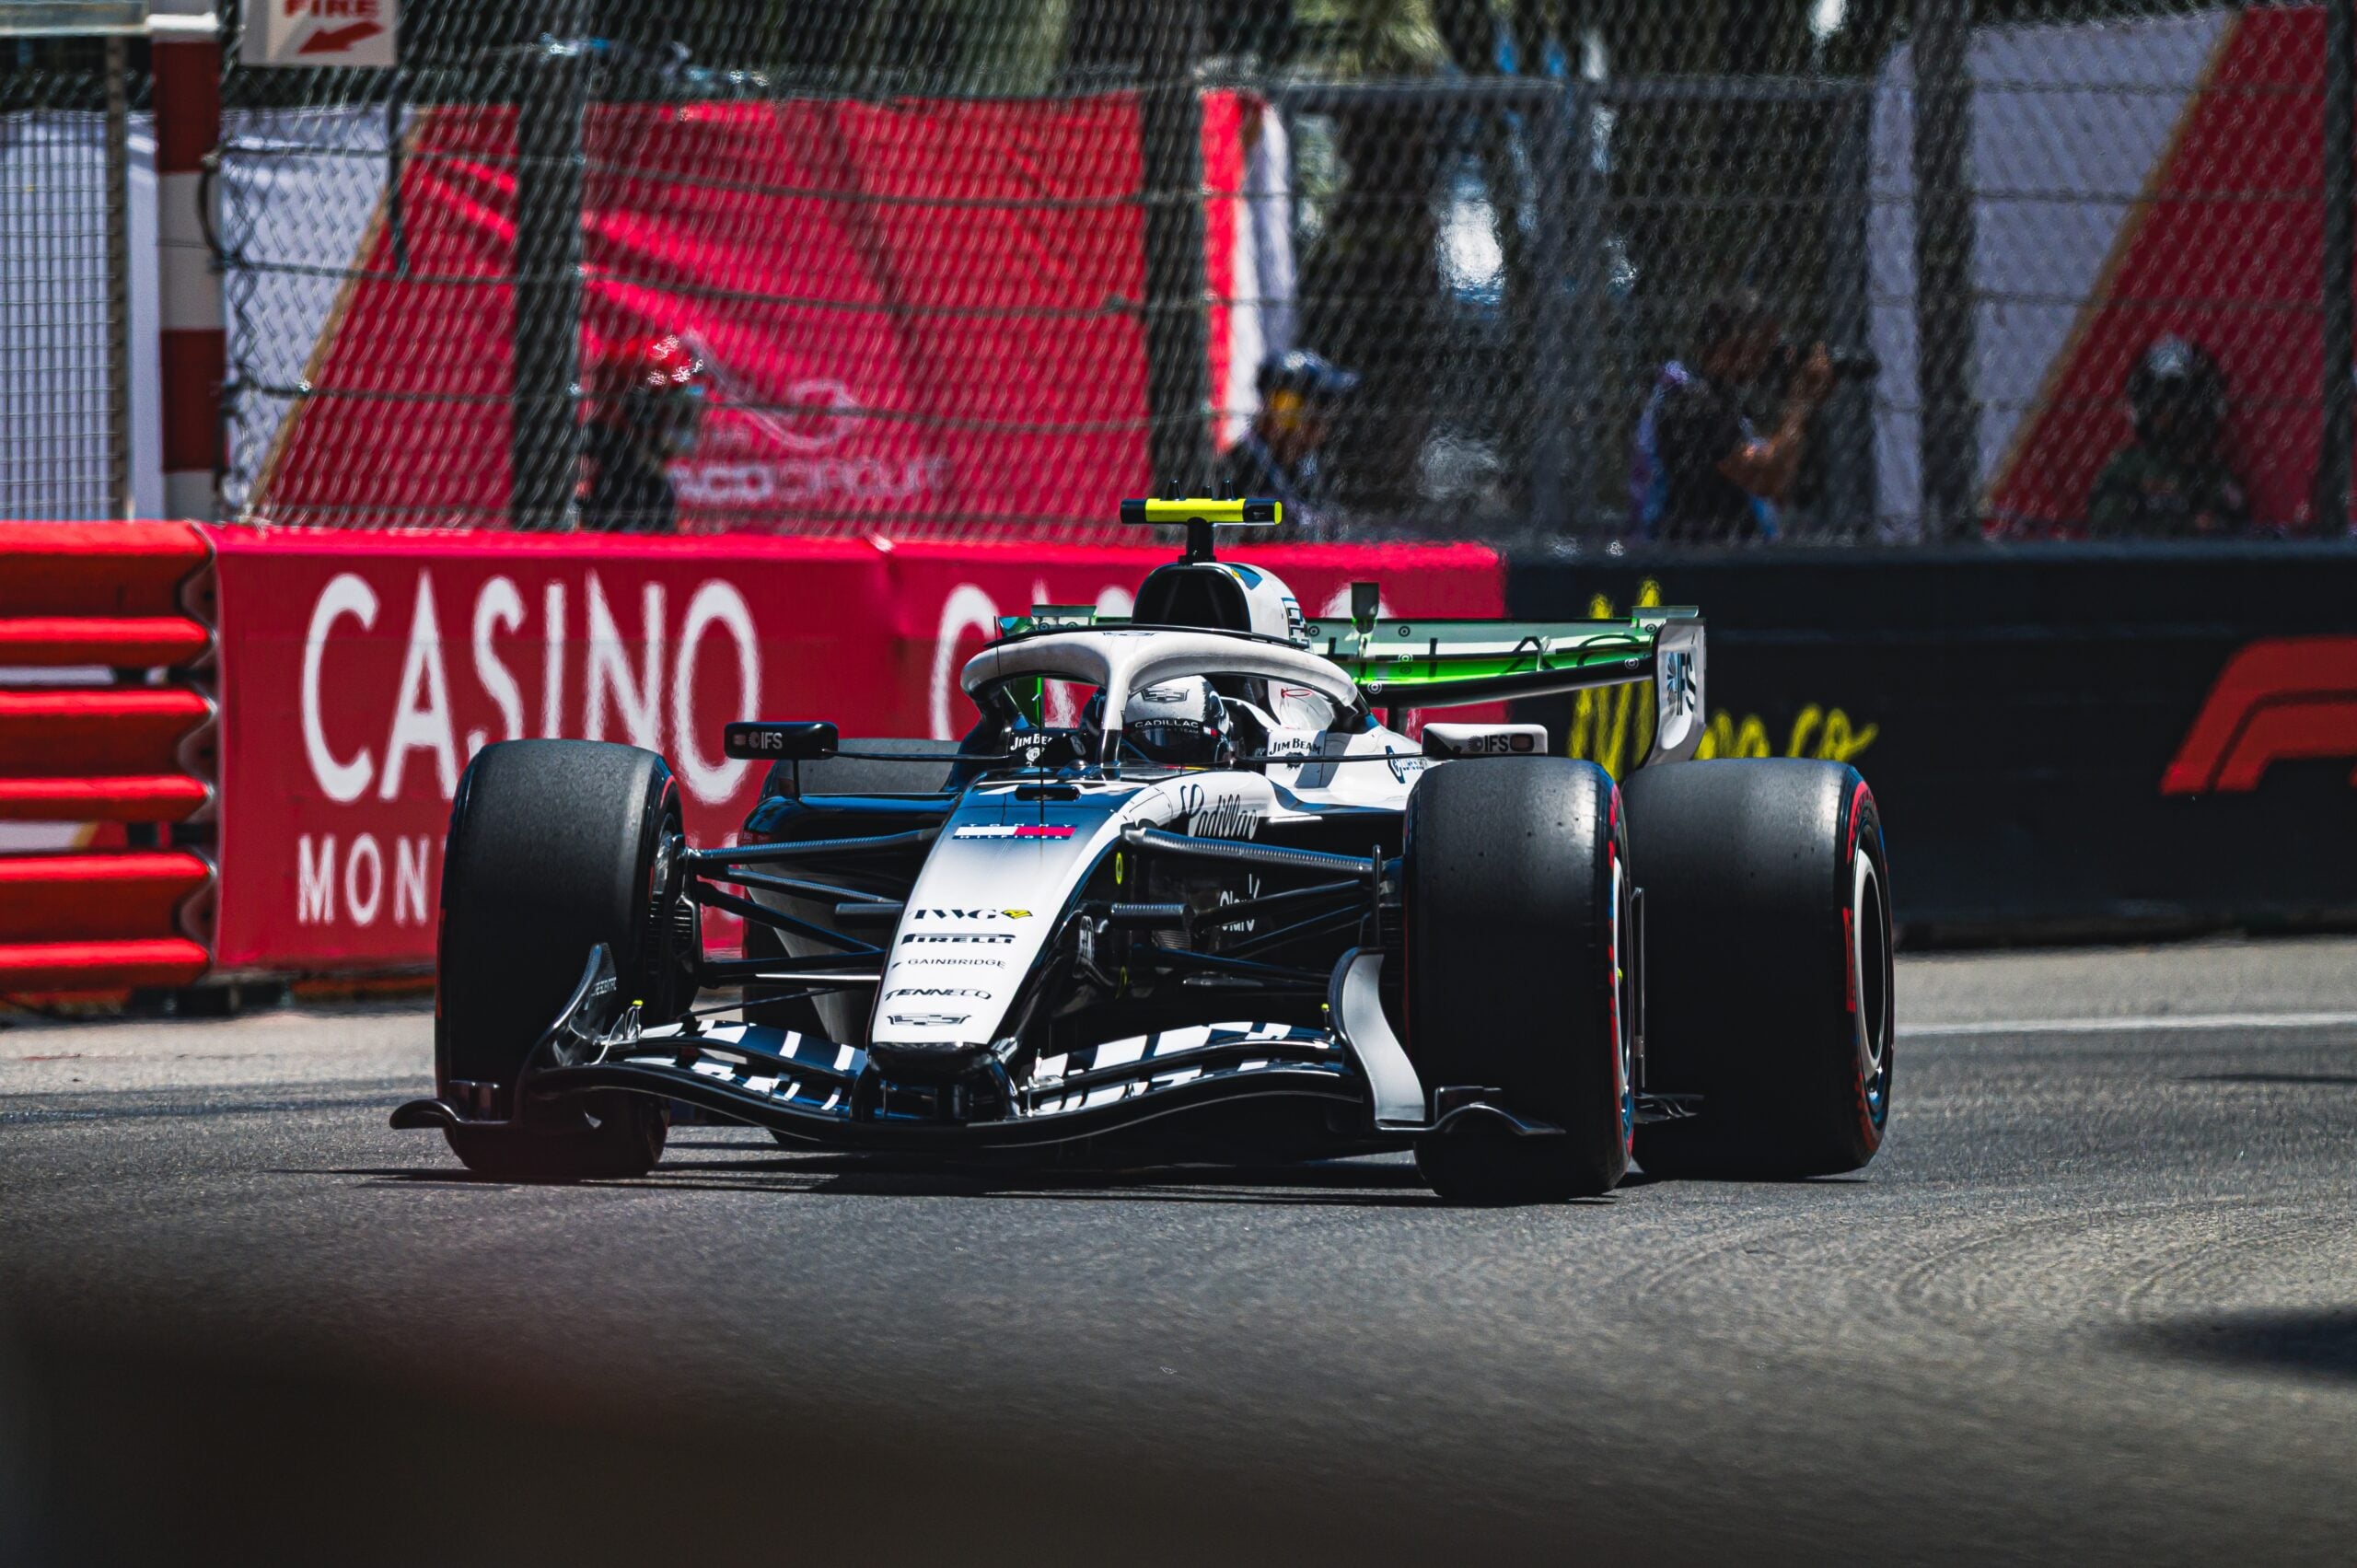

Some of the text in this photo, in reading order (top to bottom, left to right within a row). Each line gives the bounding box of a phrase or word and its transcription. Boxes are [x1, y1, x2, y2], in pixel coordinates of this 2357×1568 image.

[300, 565, 762, 808] CASINO
[2159, 633, 2357, 796] F
[1134, 719, 1199, 728] CADILLAC
[761, 731, 783, 749] IFS
[1010, 736, 1032, 750] JIM
[1269, 738, 1322, 755] JIM BEAM
[1484, 735, 1509, 752] IFS
[297, 832, 447, 926] MON
[900, 933, 1016, 946] PIRELLI
[908, 958, 1006, 970] GAINBRIDGE
[884, 988, 992, 1002] TENNECO
